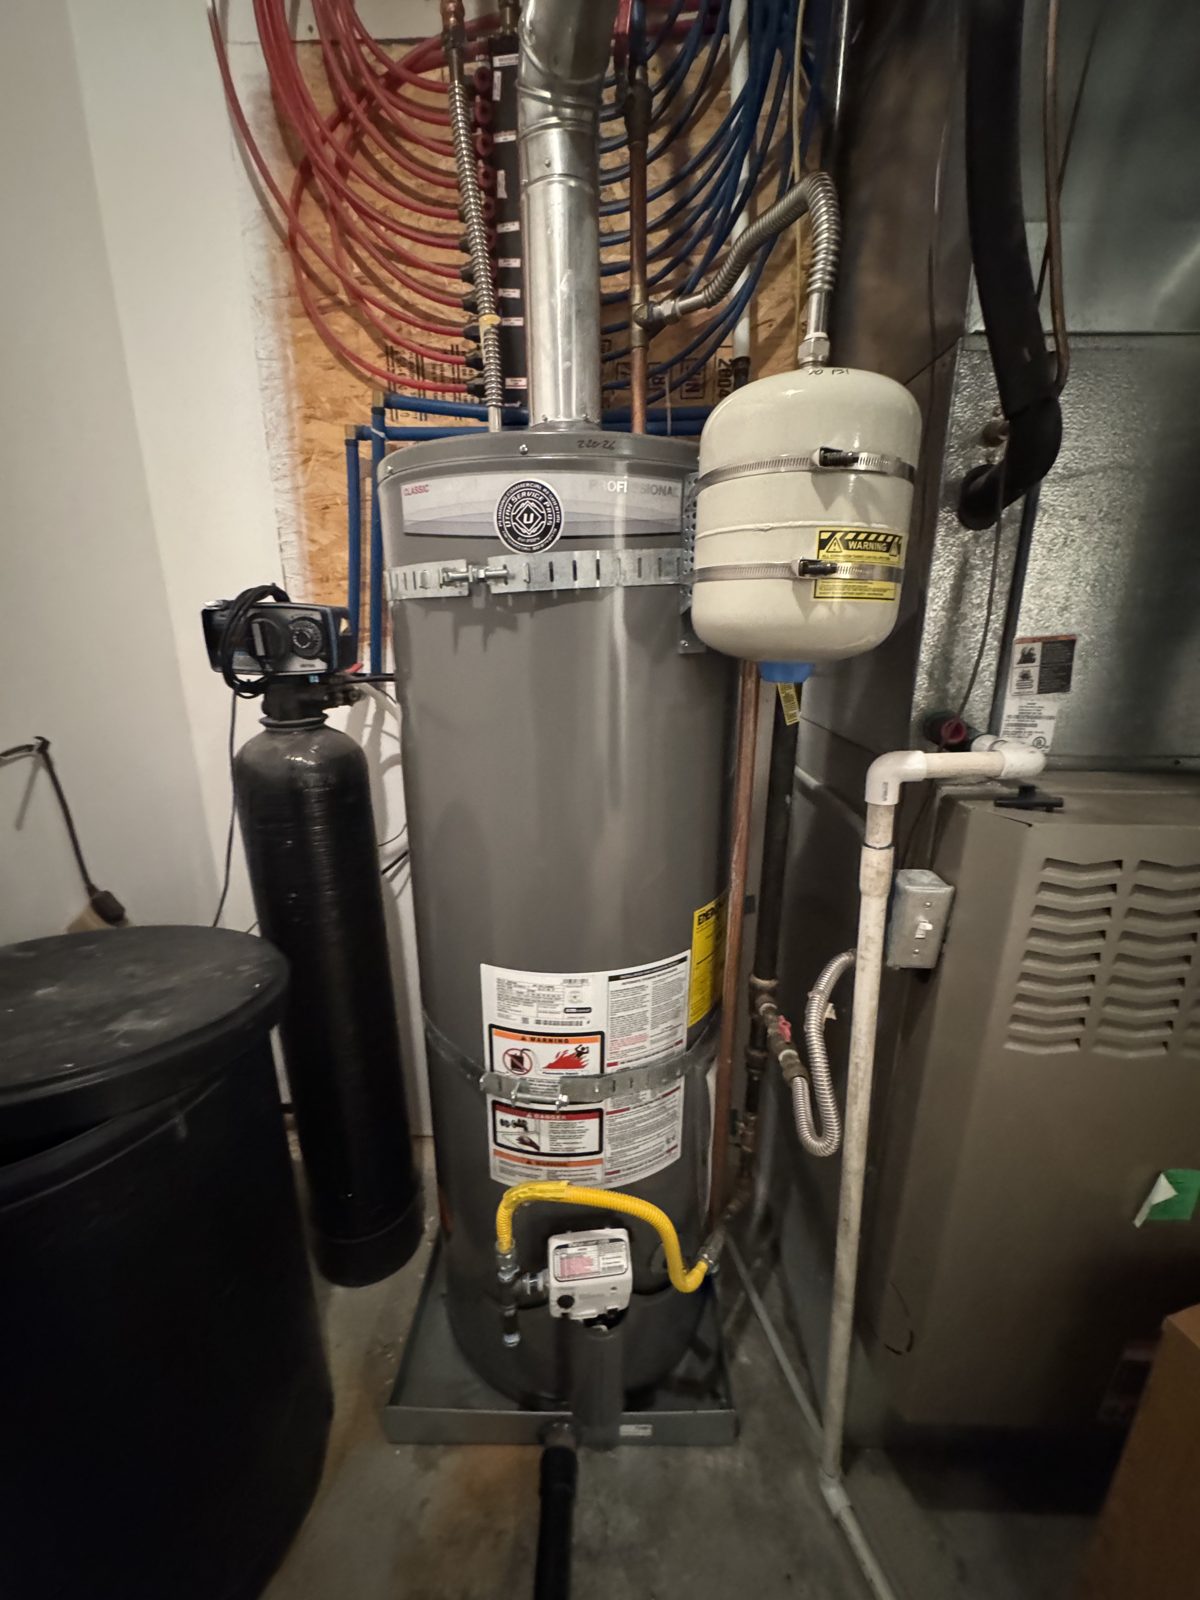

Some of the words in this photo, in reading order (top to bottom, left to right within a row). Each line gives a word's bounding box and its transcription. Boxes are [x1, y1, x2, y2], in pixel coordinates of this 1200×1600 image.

[504, 502, 514, 528] UTAH
[511, 491, 545, 503] SERVICE
[543, 501, 553, 526] PROS
[523, 513, 534, 524] U
[848, 541, 888, 551] WARNING
[530, 1036, 569, 1044] WARNING
